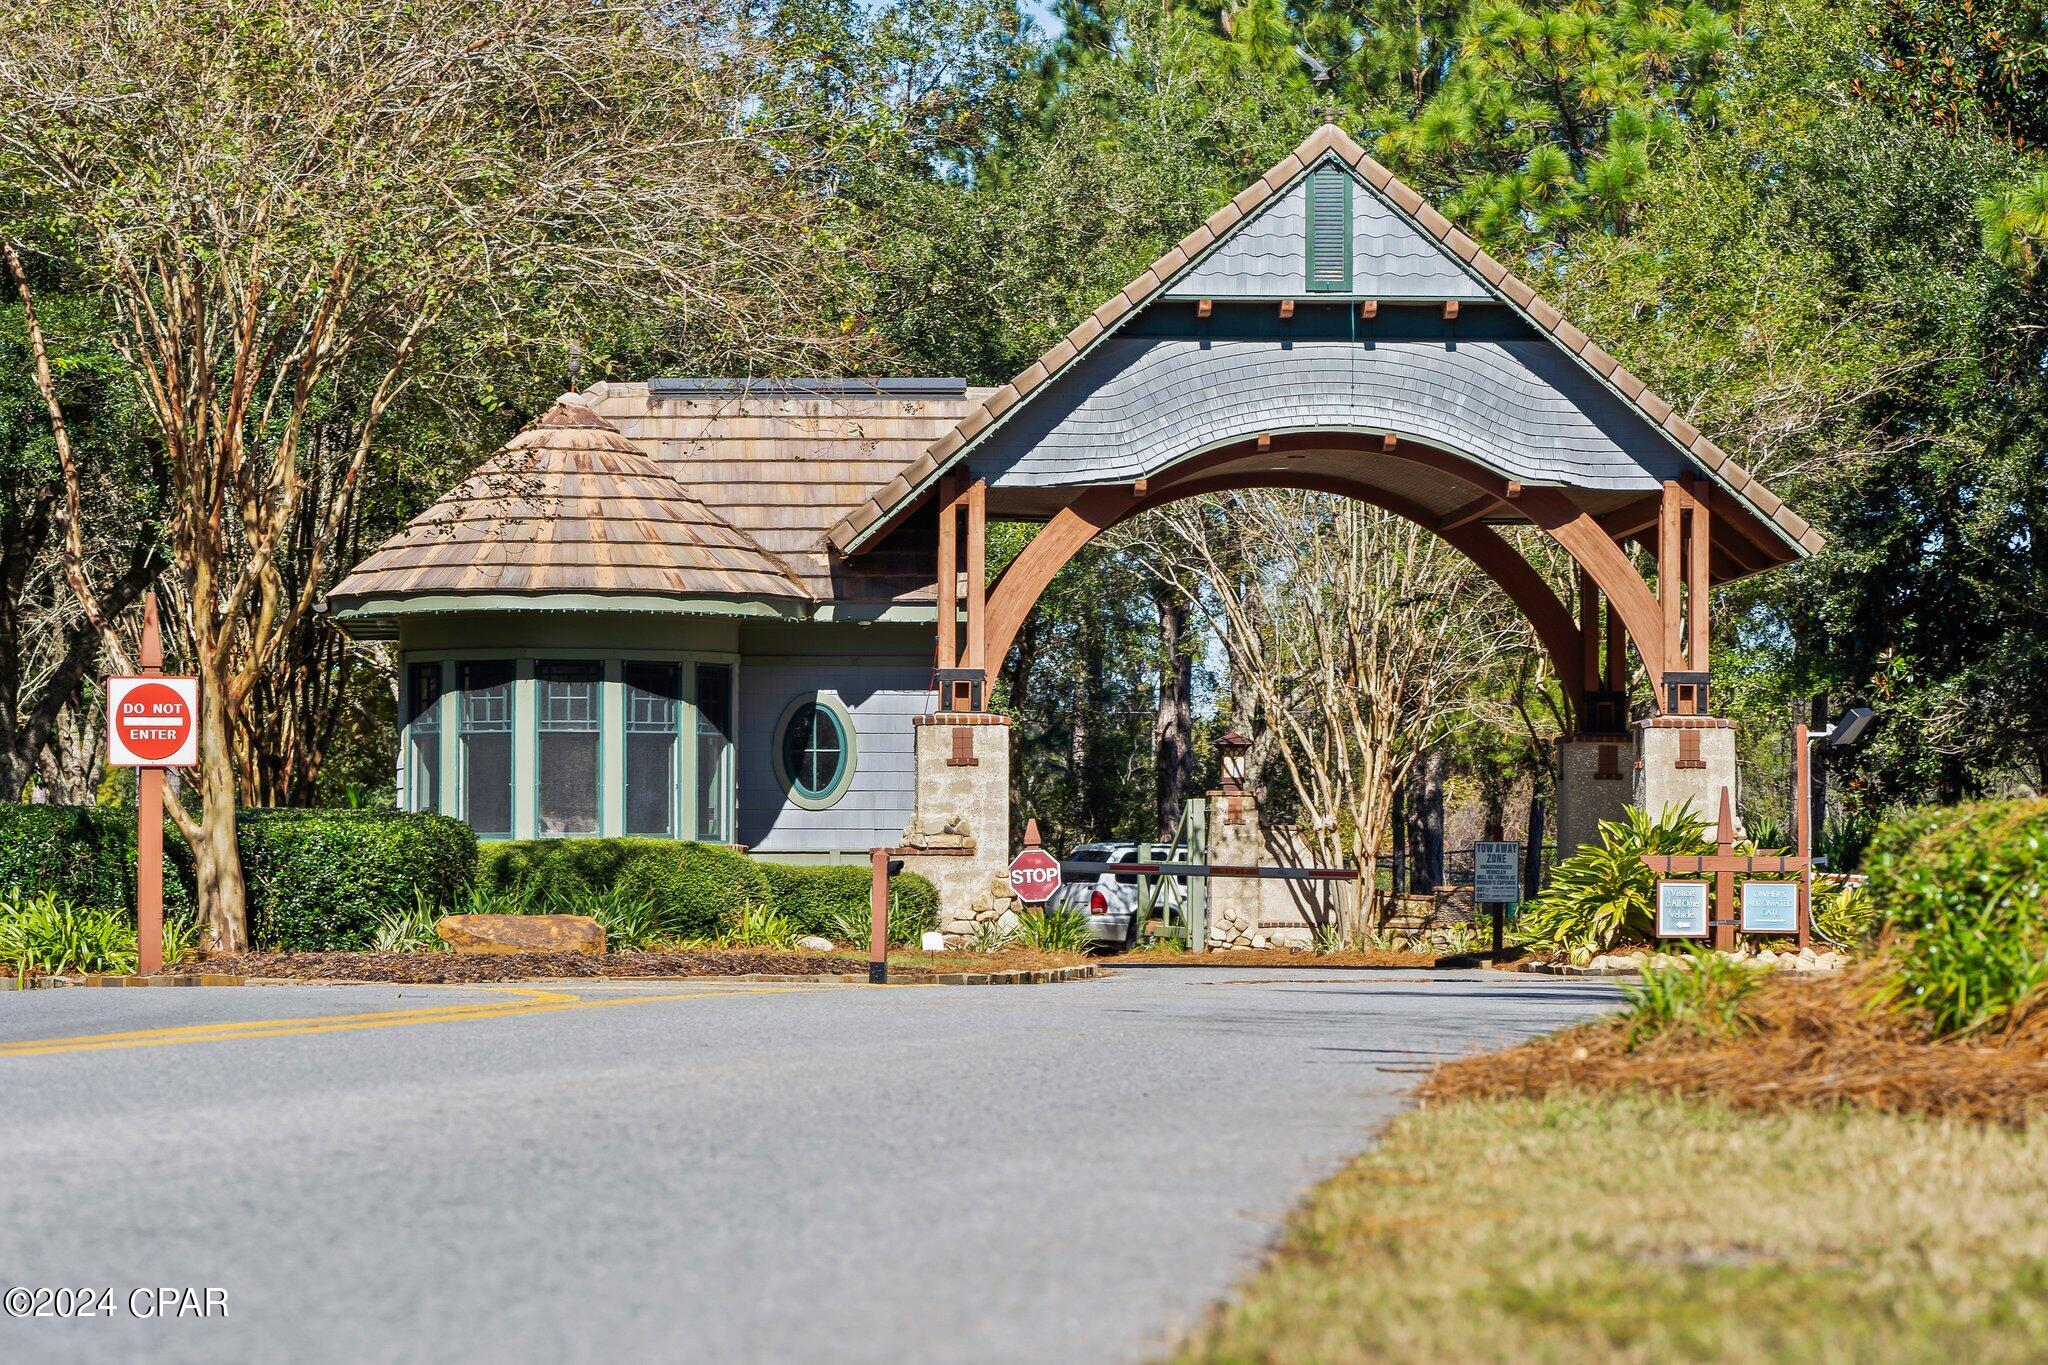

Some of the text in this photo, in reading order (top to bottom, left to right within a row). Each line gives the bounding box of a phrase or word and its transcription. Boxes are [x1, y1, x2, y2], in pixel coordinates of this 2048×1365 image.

[123, 703, 183, 714] DO NOT
[130, 729, 177, 740] ENTER
[1477, 843, 1517, 854] TOW AWAY
[1487, 854, 1507, 863] ZONE
[1011, 867, 1058, 885] STOP
[1671, 889, 1696, 897] Visitors
[1671, 899, 1681, 908] All
[1682, 899, 1701, 908] Other
[1670, 910, 1697, 919] Vehicles
